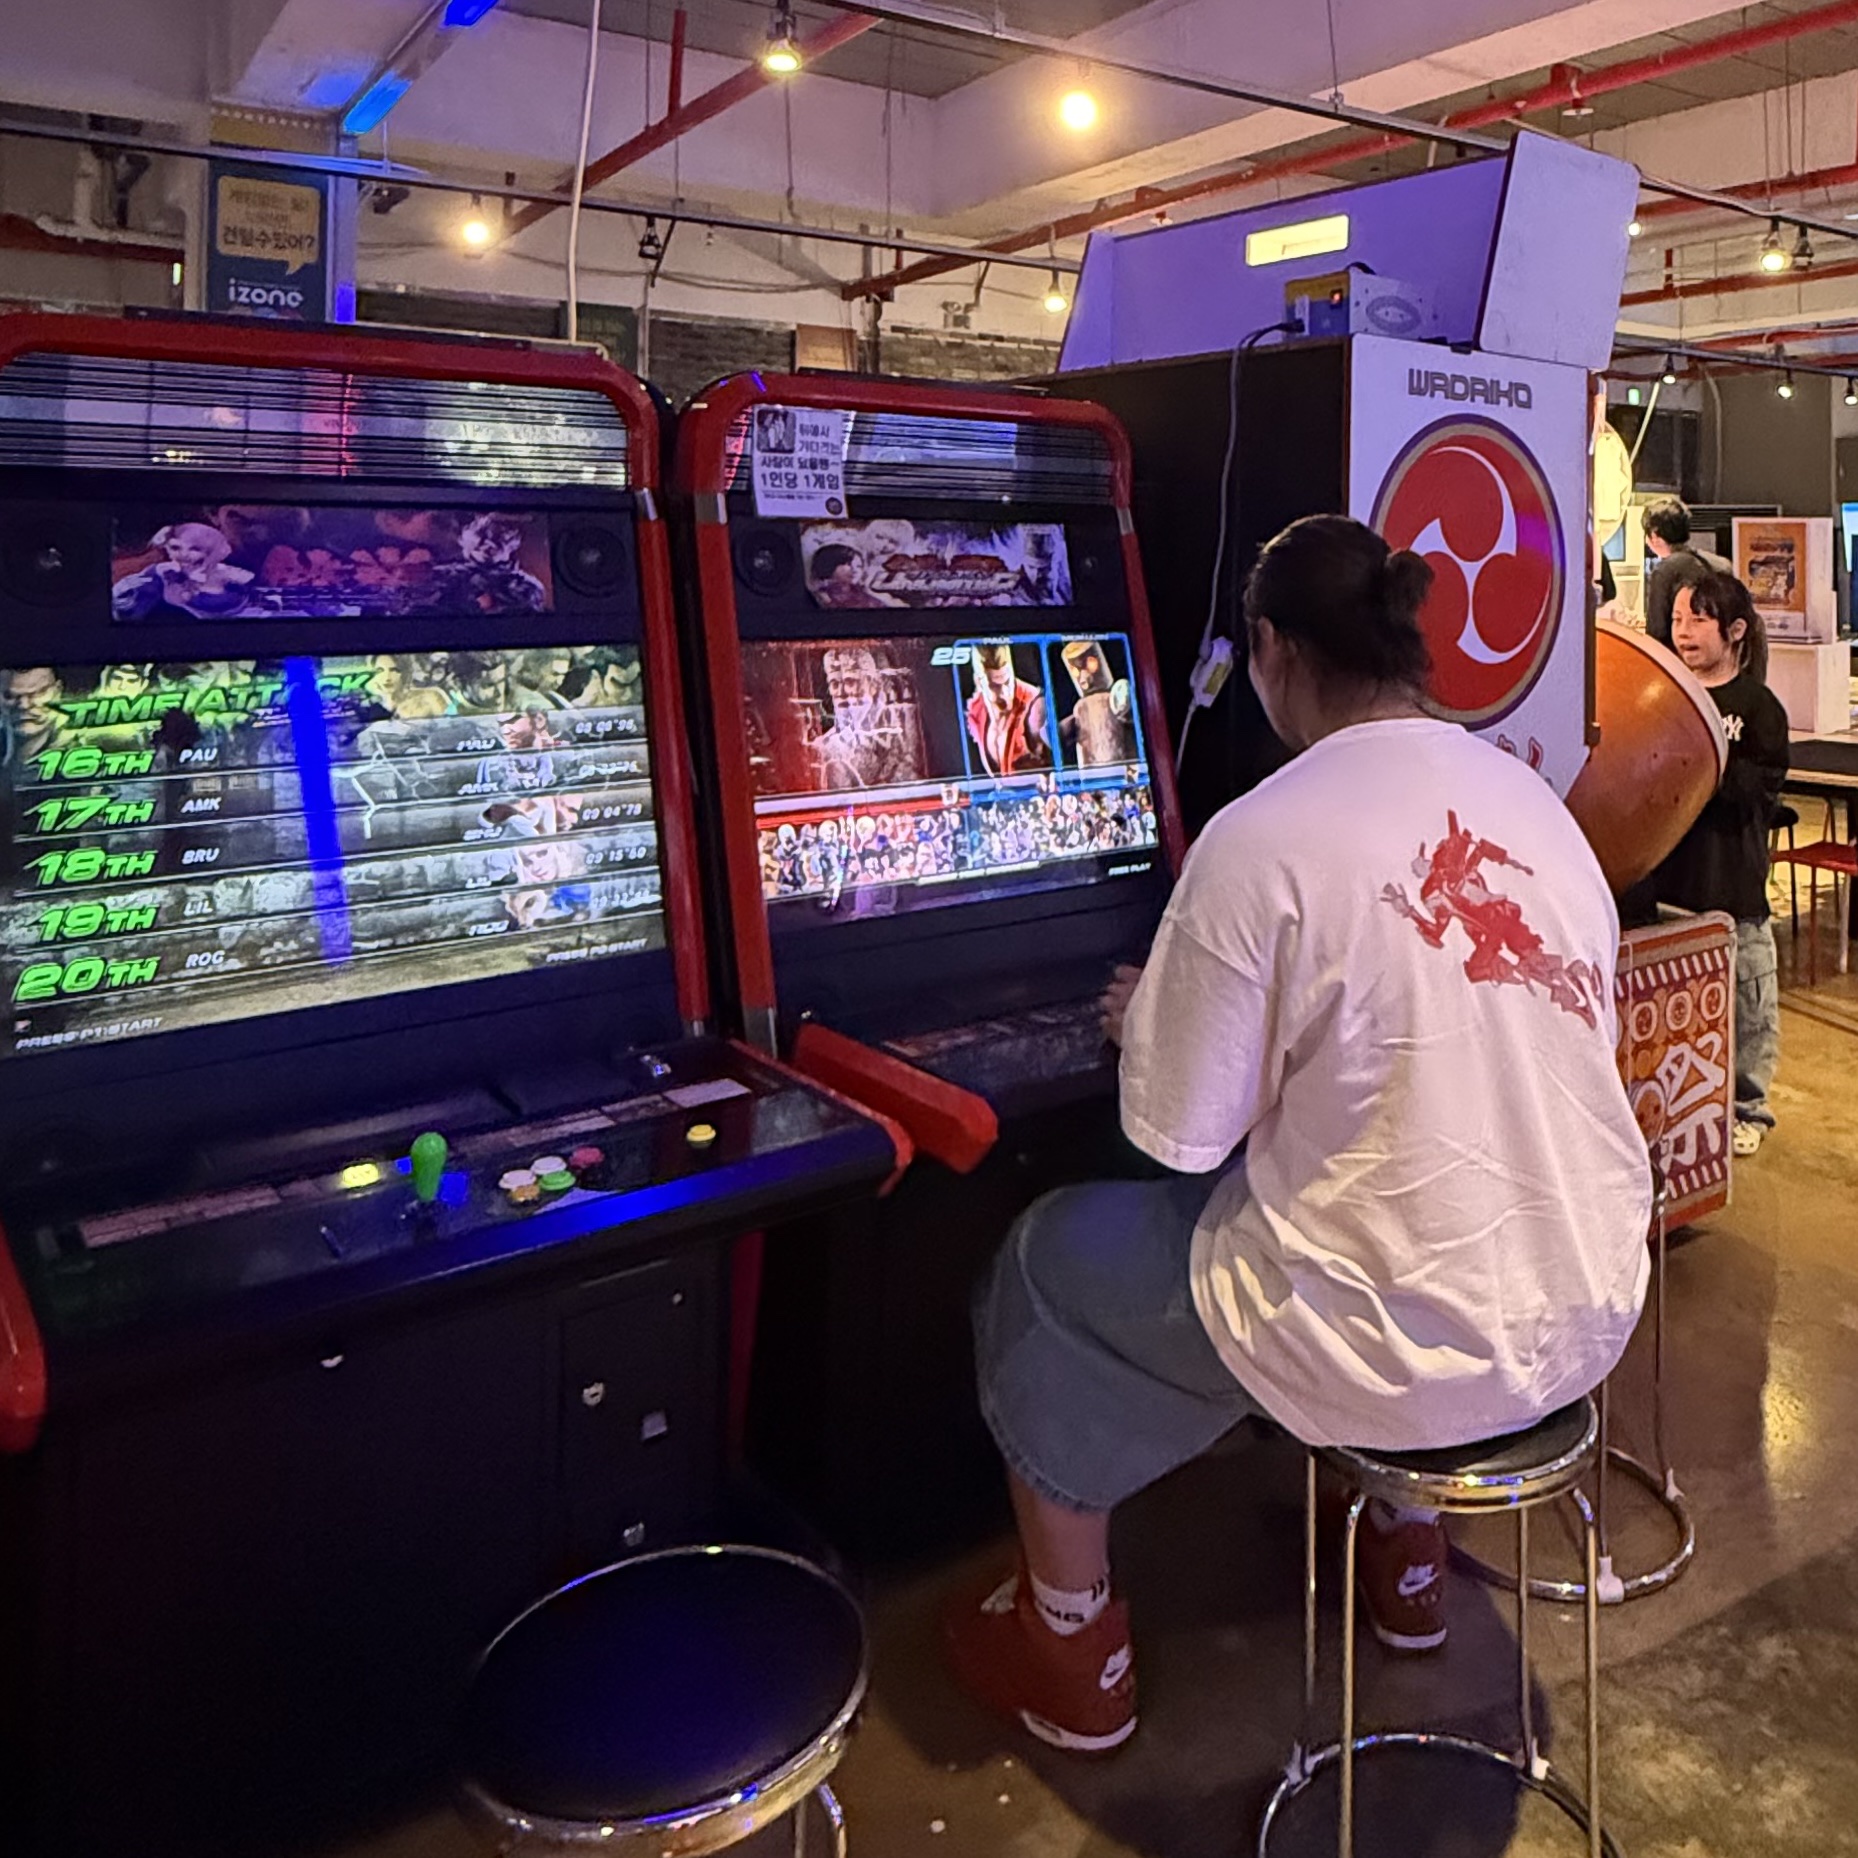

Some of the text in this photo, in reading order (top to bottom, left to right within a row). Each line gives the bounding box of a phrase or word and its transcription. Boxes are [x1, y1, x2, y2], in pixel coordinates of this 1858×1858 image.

[761, 472, 840, 490] 1인당 1게임
[60, 674, 371, 728] TIME ATTCK
[26, 747, 217, 781] 16TH PAU
[26, 795, 156, 831] 17TH
[26, 847, 220, 886] 18TH BRU
[28, 901, 158, 941] 19TH
[12, 956, 160, 1002] 20TH
